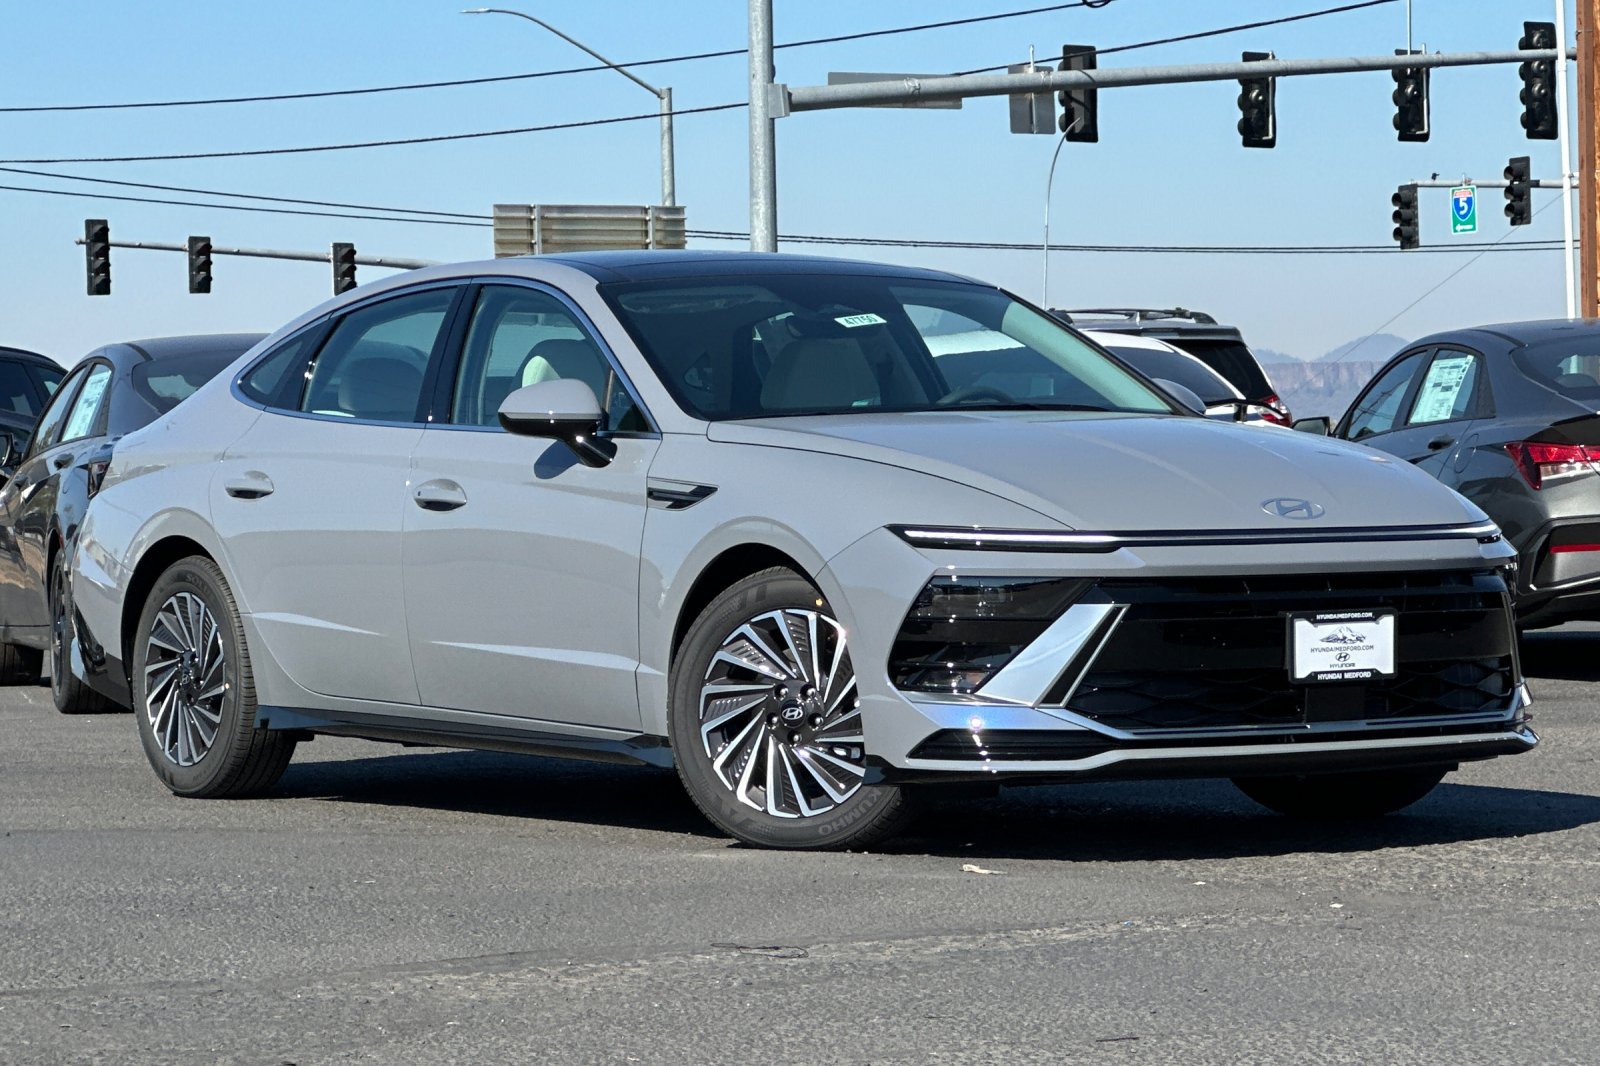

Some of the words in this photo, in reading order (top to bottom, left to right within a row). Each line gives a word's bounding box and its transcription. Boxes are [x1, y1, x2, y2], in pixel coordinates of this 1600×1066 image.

[1459, 197, 1468, 215] 5
[1316, 612, 1373, 620] HYUNDAIMEDFORD.COM
[1310, 645, 1374, 653] HYUNDAIMEDFORD.COM
[1344, 671, 1372, 679] MEDFORD
[818, 787, 882, 835] KUMHO
